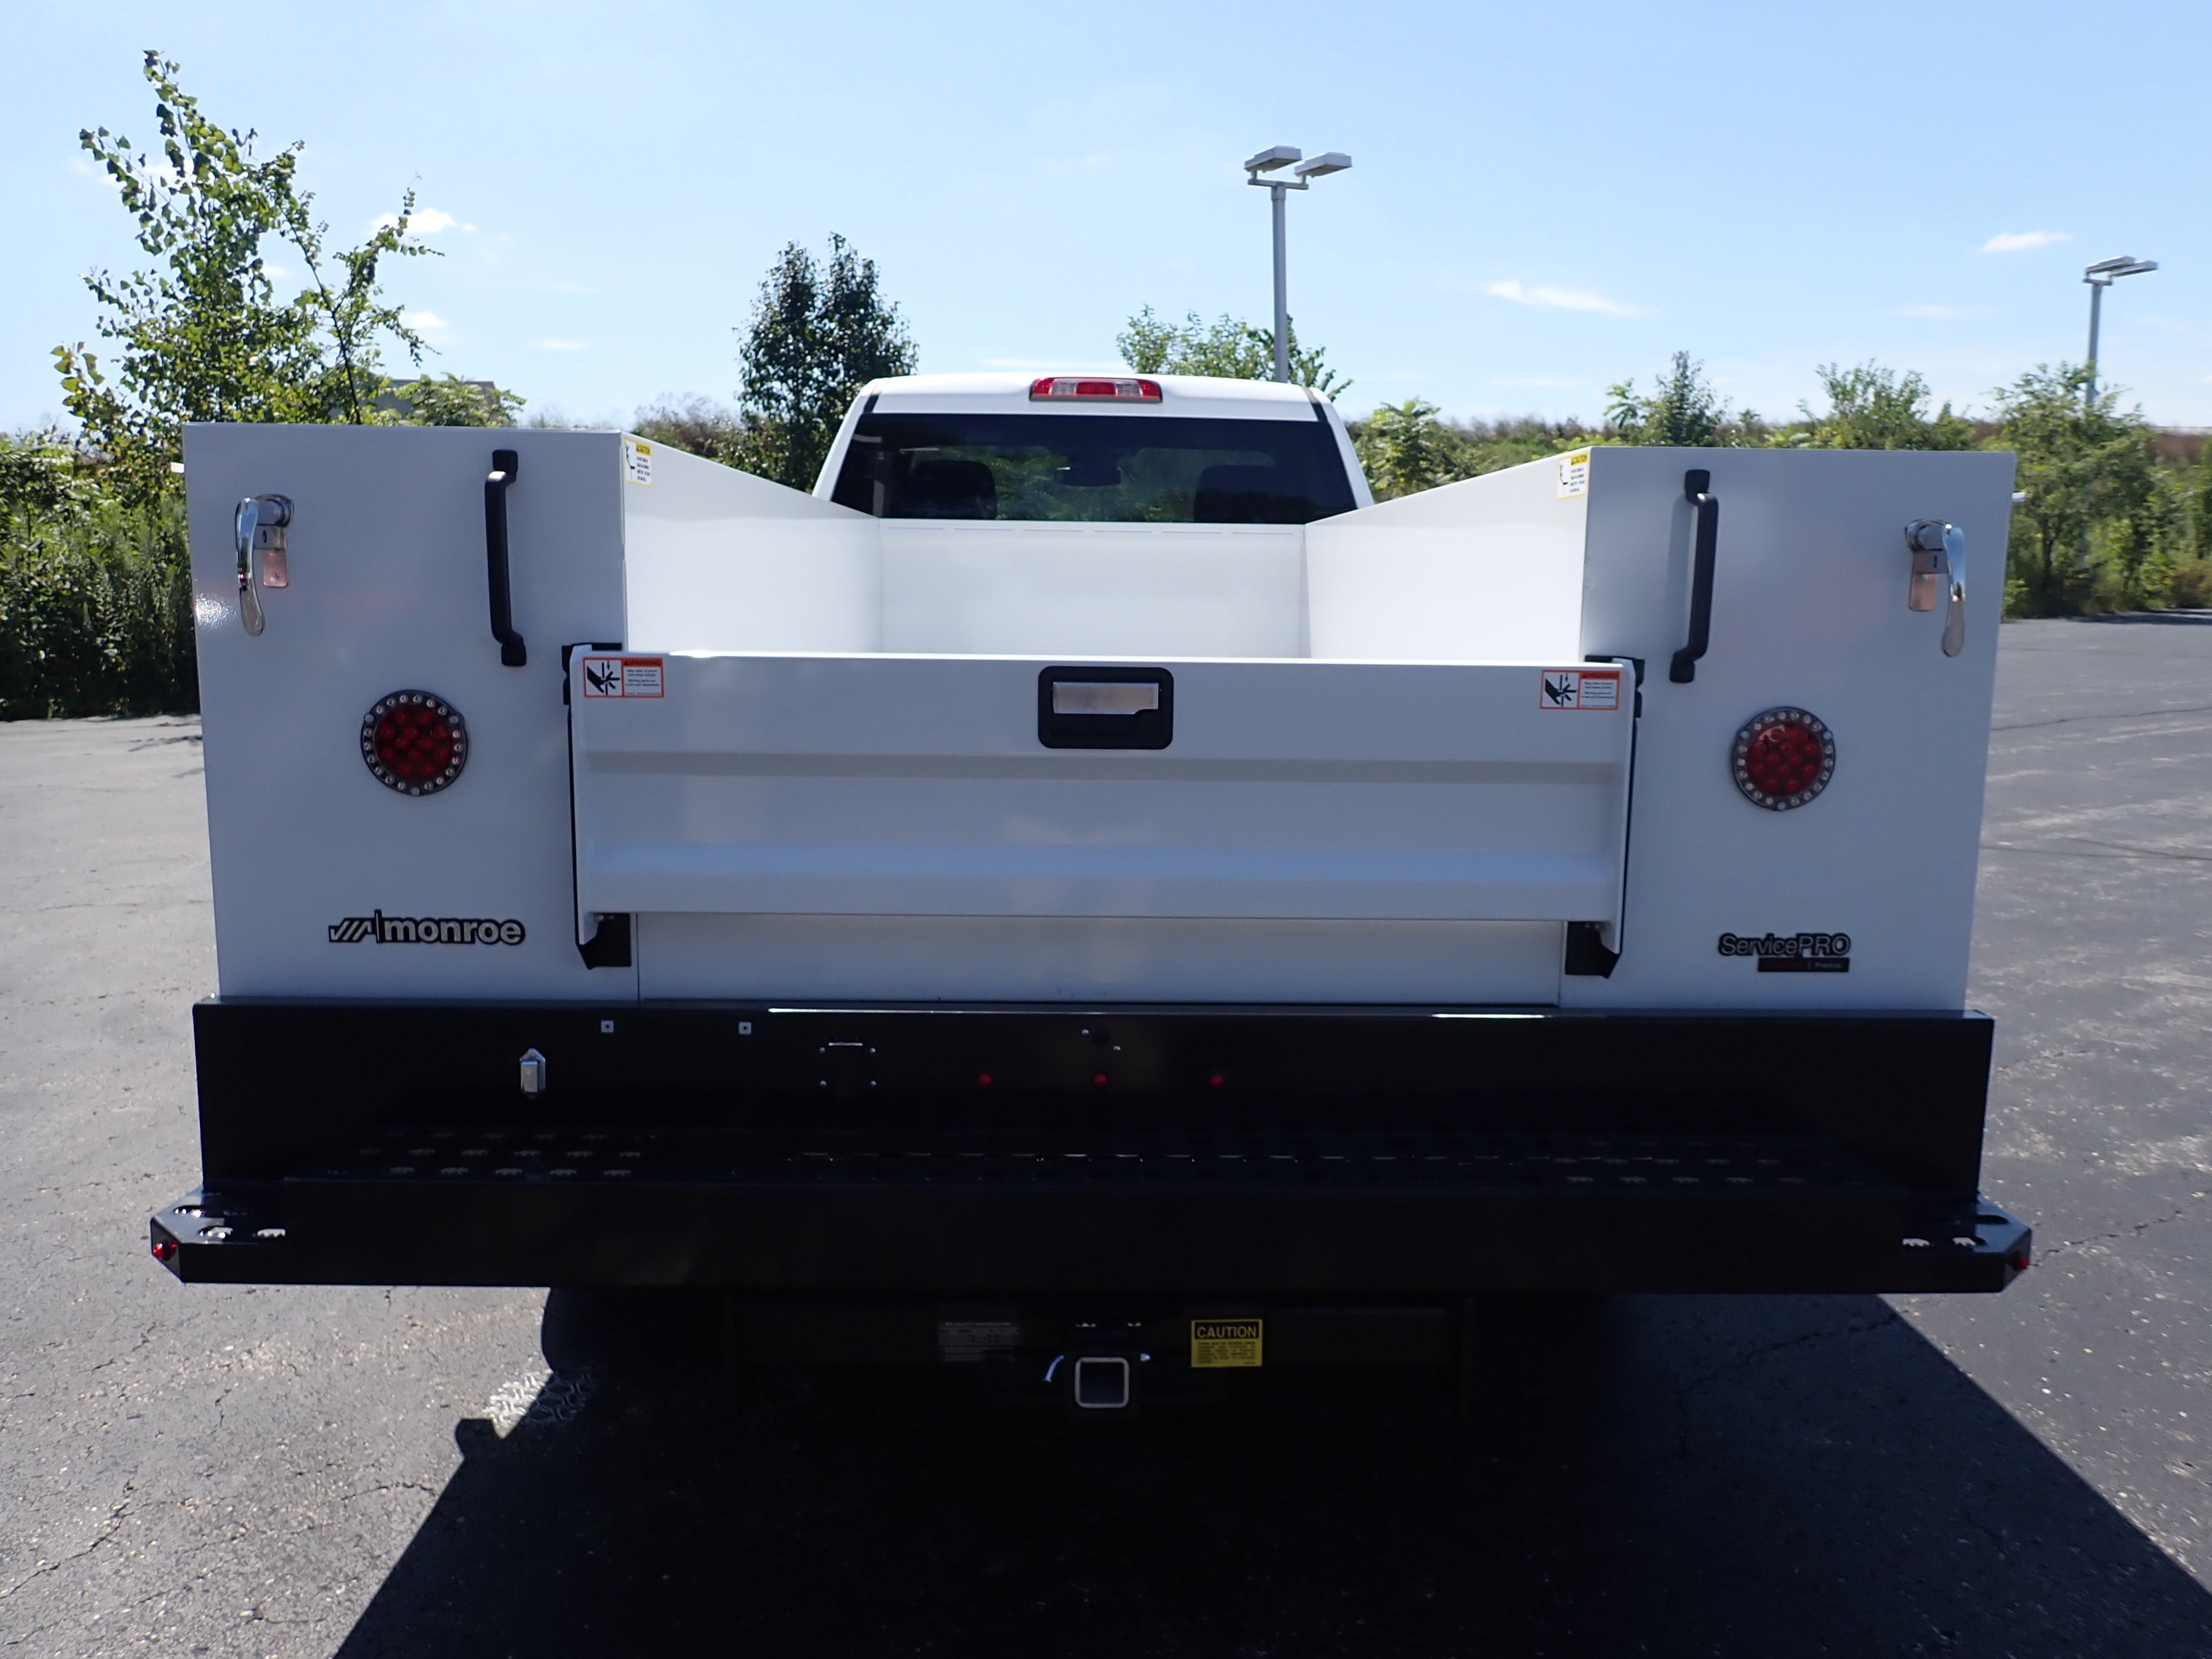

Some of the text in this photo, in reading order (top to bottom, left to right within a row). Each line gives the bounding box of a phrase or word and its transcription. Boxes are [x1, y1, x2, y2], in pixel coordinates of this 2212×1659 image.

[383, 917, 525, 946] monroe
[1718, 933, 1851, 956] ServicePRO
[1196, 1326, 1257, 1338] CAUTION
